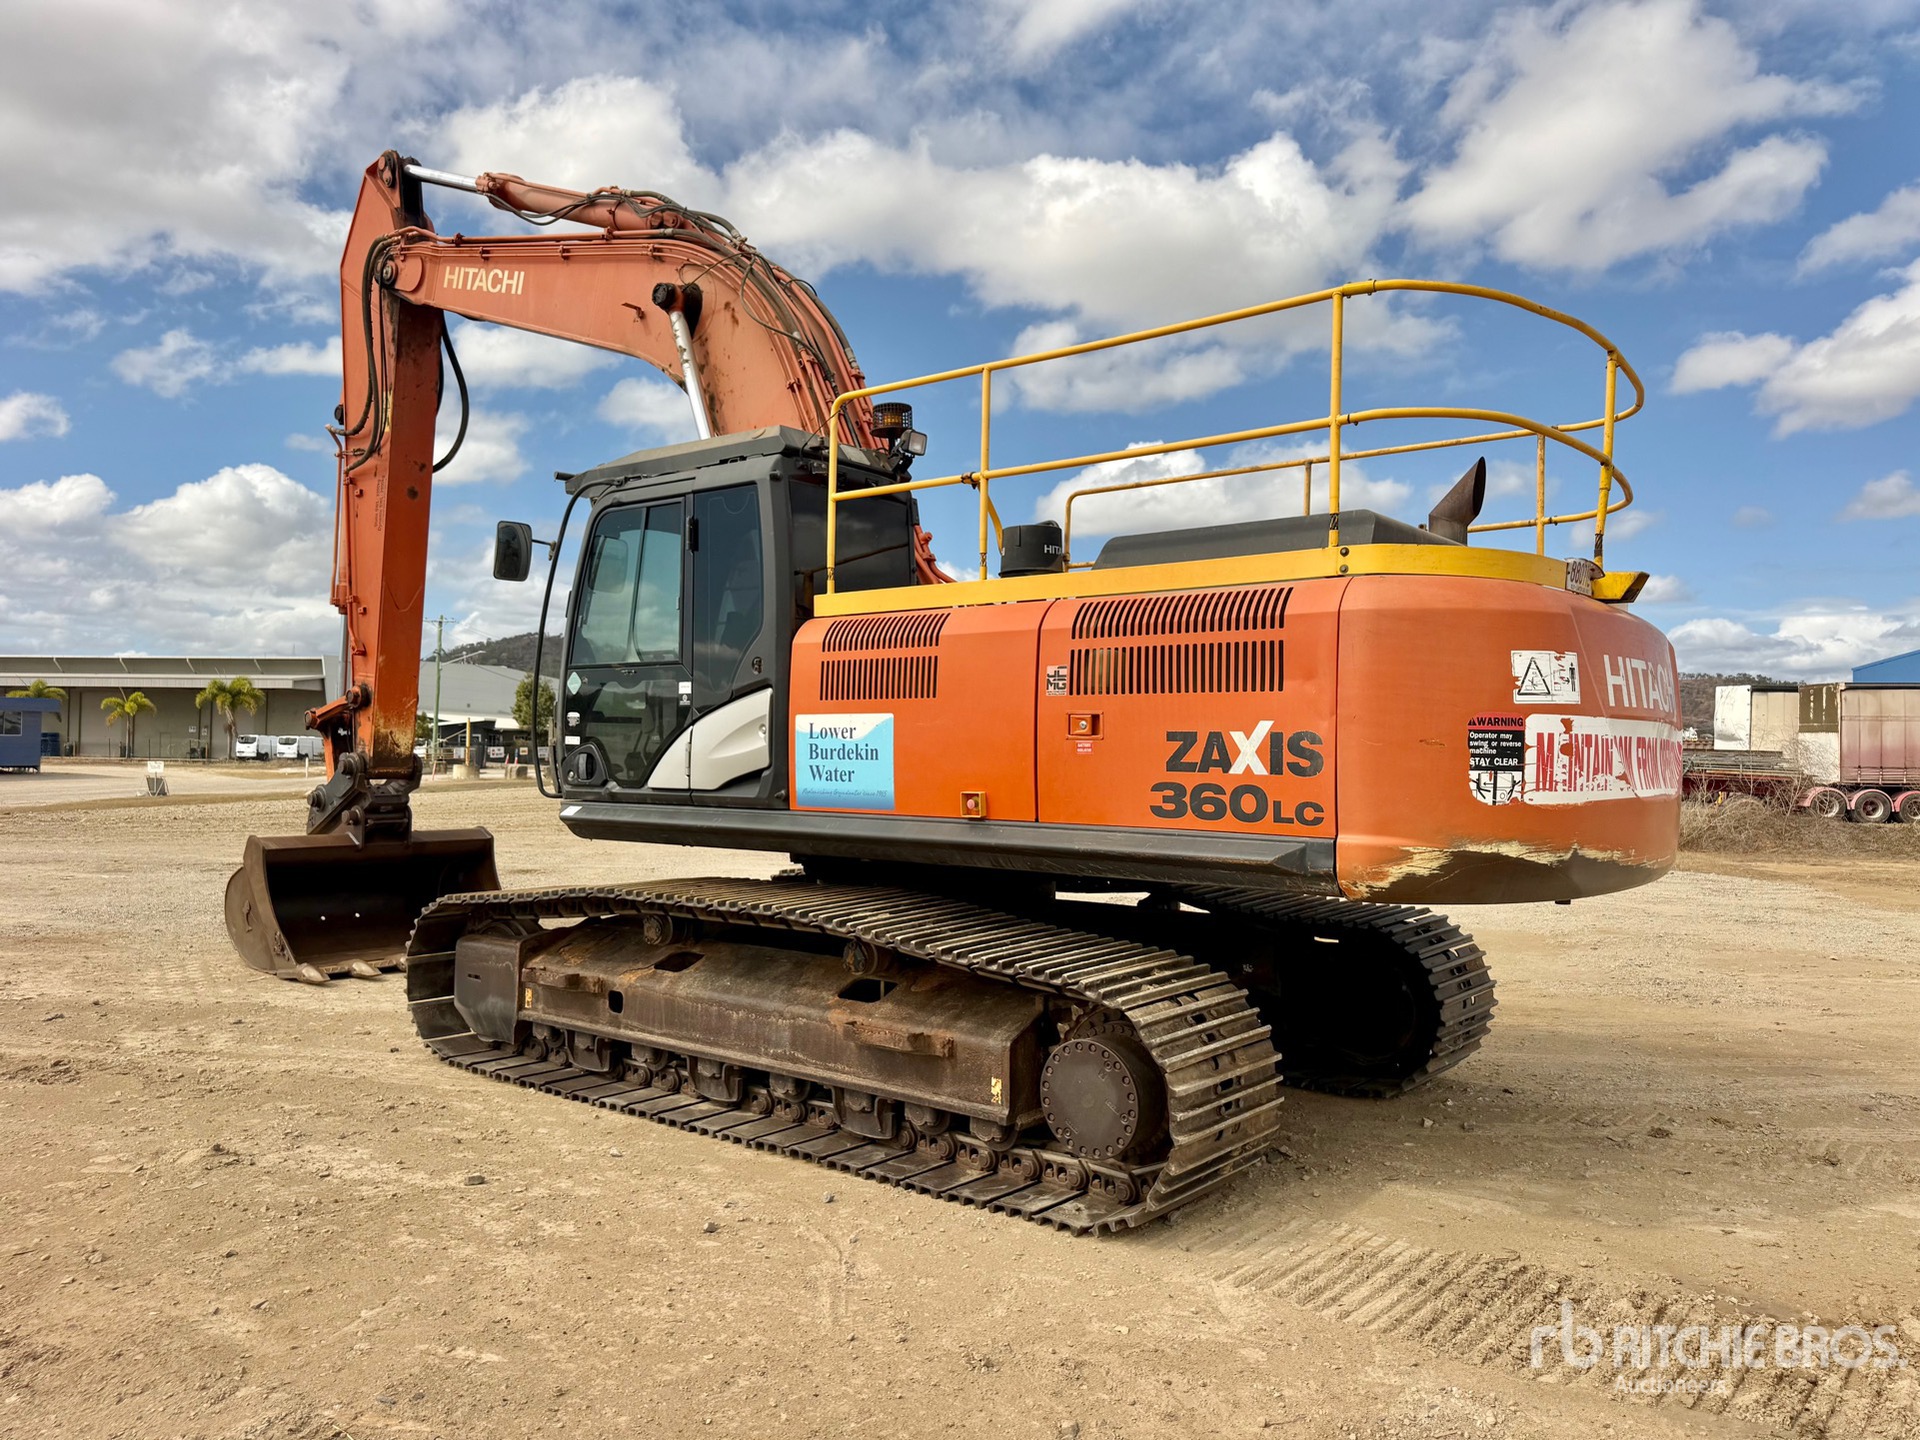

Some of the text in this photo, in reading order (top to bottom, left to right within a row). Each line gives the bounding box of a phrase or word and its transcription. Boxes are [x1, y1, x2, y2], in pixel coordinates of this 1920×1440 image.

[443, 266, 525, 295] HITACHI
[1476, 717, 1523, 727] WARNING
[808, 722, 856, 740] Lower
[1469, 731, 1498, 739] Operator
[1165, 720, 1324, 778] ZAXIS
[1469, 740, 1489, 749] swing
[1469, 747, 1497, 755] machine
[808, 743, 880, 761] Burdekin
[1469, 757, 1519, 766] STAY CLEAR
[808, 764, 856, 783] Water
